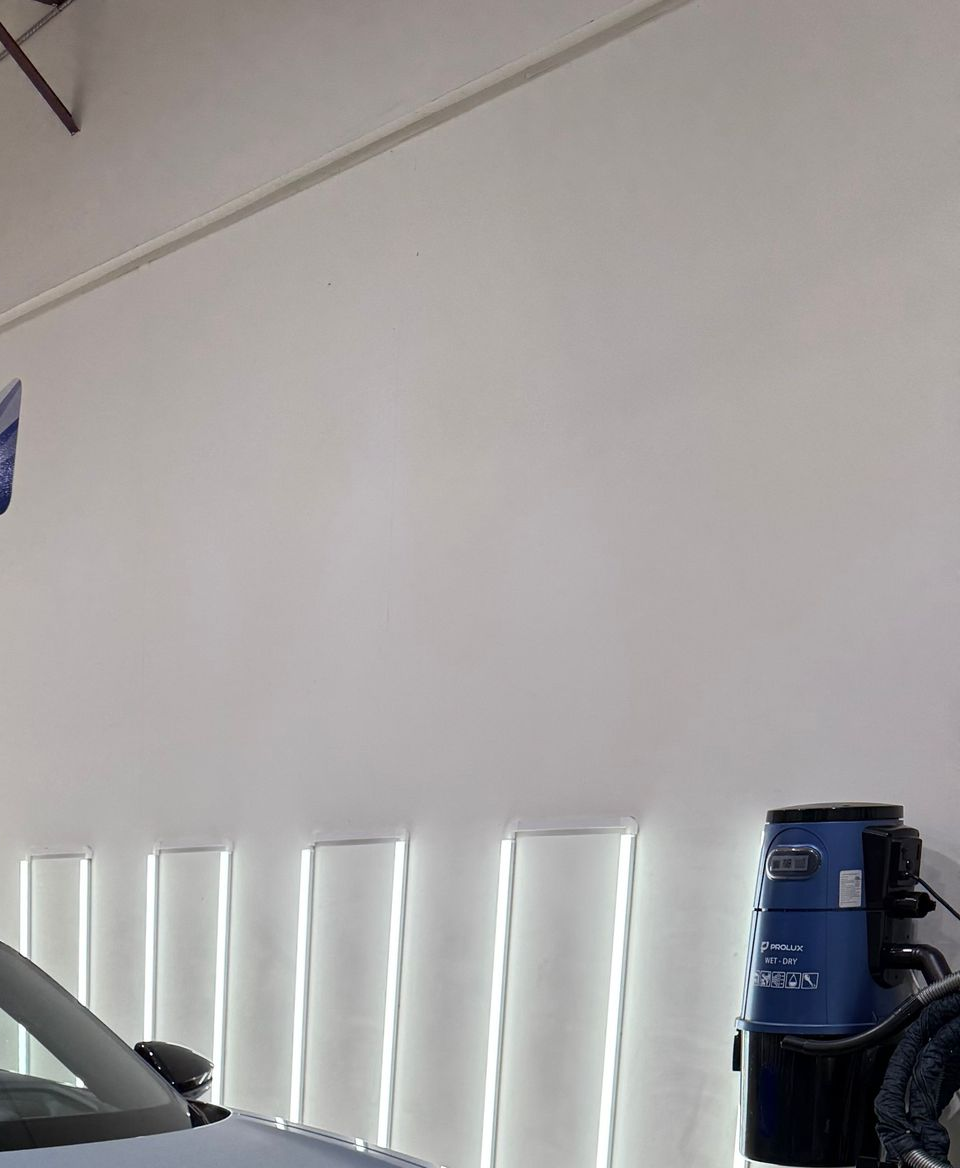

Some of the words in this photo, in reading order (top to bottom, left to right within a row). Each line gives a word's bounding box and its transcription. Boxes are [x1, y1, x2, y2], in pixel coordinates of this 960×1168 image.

[770, 943, 804, 952] PROLUX
[765, 957, 778, 965] WET
[782, 957, 798, 965] DRY
